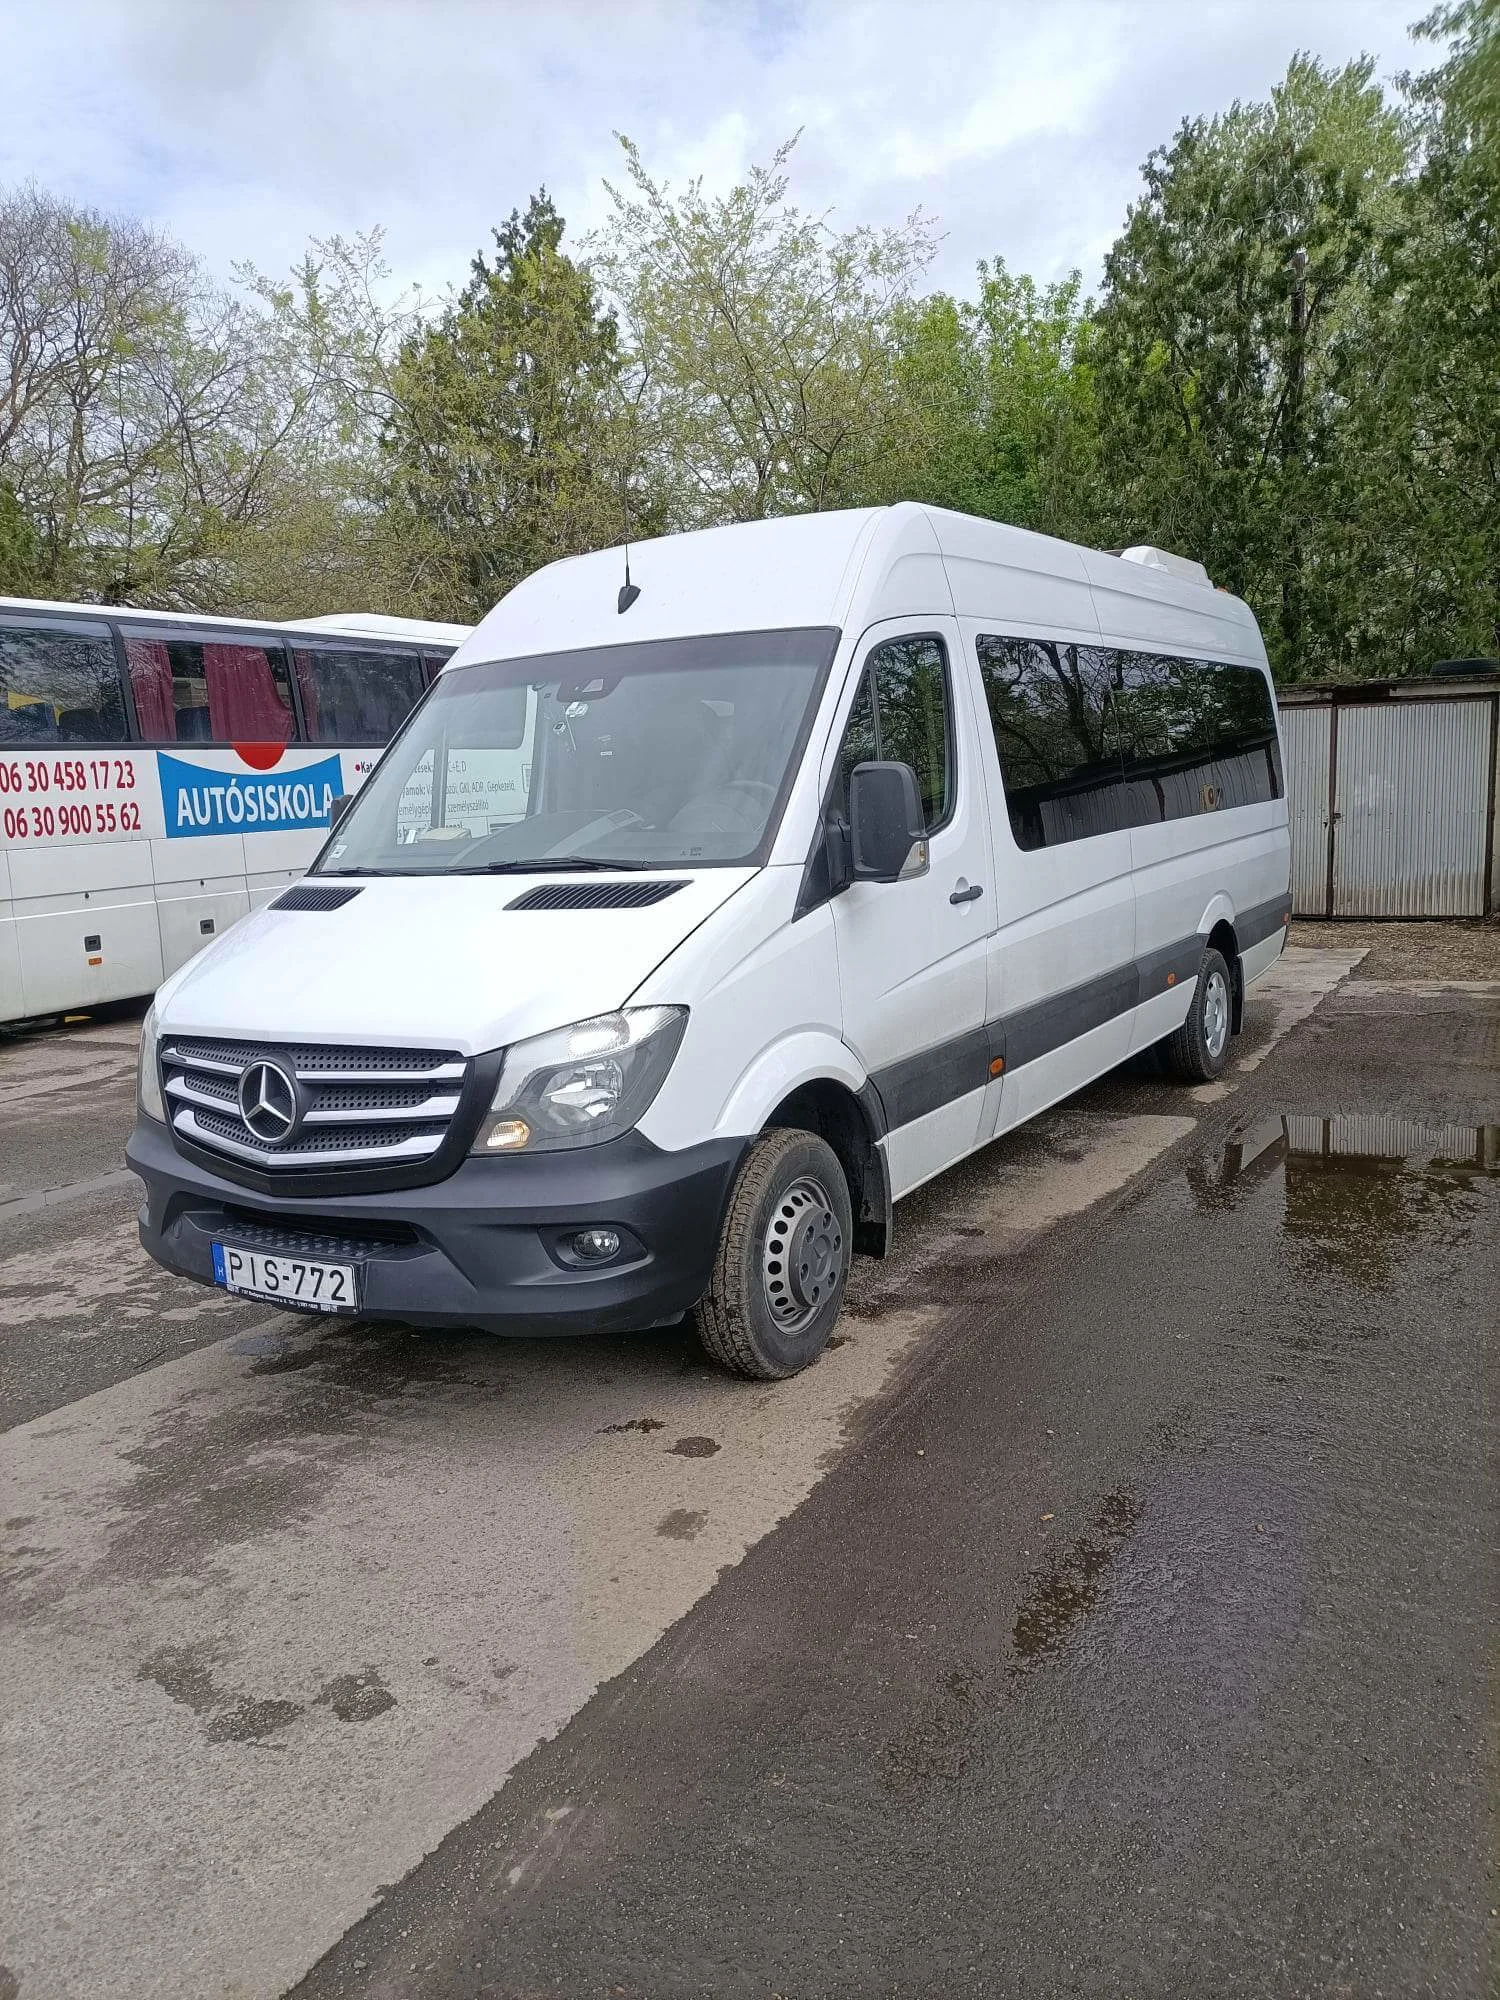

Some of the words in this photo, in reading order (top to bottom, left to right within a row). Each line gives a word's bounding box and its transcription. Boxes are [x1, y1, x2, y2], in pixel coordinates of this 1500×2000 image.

[0, 762, 22, 793] 06
[26, 762, 49, 792] 30
[54, 761, 87, 791] 458
[90, 761, 109, 789] 17
[114, 760, 135, 789] 23
[4, 807, 28, 839] 06
[32, 806, 54, 837] 30
[59, 804, 92, 835] 900
[96, 803, 117, 833] 55
[120, 802, 142, 831] 62
[177, 778, 333, 827] AUTÓSISKOLA
[228, 1251, 347, 1303] PIS-772
